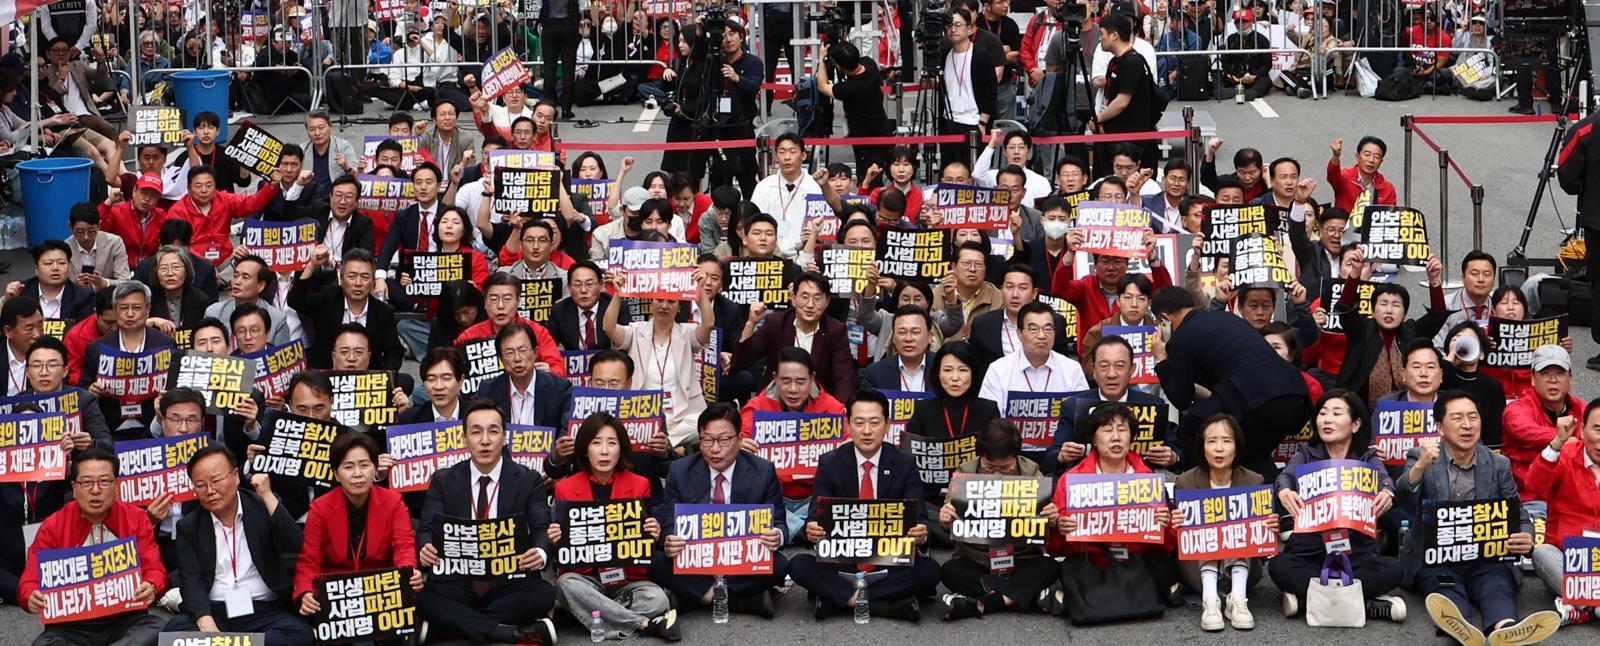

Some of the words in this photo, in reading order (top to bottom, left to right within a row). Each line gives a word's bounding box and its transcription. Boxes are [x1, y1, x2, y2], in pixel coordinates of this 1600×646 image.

[50, 2, 83, 10] SECURITY
[244, 127, 283, 153] 민생파탄
[224, 145, 260, 168] 이재명
[237, 138, 280, 166] 사법파괴
[373, 180, 387, 197] 혐의
[388, 180, 401, 197] 5개
[502, 171, 552, 185] 민생파탄
[502, 185, 550, 199] 사법파괴
[593, 182, 607, 199] 5개
[938, 189, 955, 205] 12개
[956, 189, 974, 204] 혐의
[975, 190, 990, 204] 5개
[991, 189, 1010, 204] 재판
[495, 198, 529, 212] 이재명
[532, 199, 559, 212] OUT
[940, 207, 966, 223] 이재명
[966, 206, 988, 223] 재판
[988, 205, 1008, 222] 재개
[1211, 205, 1265, 225] 민생파탄
[1077, 207, 1114, 224] 제멋대로
[1114, 209, 1152, 228] 농지조사
[246, 227, 262, 246] 12개
[263, 227, 280, 246] 혐의
[282, 225, 296, 245] 5개
[298, 223, 316, 242] 재판
[886, 230, 944, 247] 민생파탄
[1210, 221, 1266, 239] 사법파괴
[1369, 226, 1426, 243] 종북외교
[275, 244, 295, 266] 재판
[623, 246, 660, 269] 제멋대로
[661, 245, 698, 268] 농지조사
[823, 249, 876, 264] 민생파탄
[884, 246, 943, 262] 사법파괴
[1202, 239, 1230, 254] 이재
[1361, 242, 1403, 259] 이재명
[1406, 243, 1429, 259] OU
[412, 253, 464, 269] 민생파탄
[729, 260, 785, 276] 민생파탄
[876, 260, 918, 276] 이재명
[920, 261, 951, 278] OUT
[413, 268, 463, 283] 사법파괴
[728, 275, 783, 290] 사법파괴
[1229, 266, 1269, 289] 이재명
[1271, 267, 1290, 283] OU
[405, 282, 442, 296] 이재명
[721, 289, 760, 305] 이재명
[762, 289, 792, 304] OUT
[1499, 318, 1560, 338] 민생파탄
[266, 341, 304, 374] 농지조사
[465, 340, 497, 361] 민생
[1488, 351, 1533, 367] 이재명
[98, 355, 115, 376] 12개
[116, 356, 135, 377] 혐의
[137, 355, 153, 375] 5개
[154, 350, 172, 371] 재판
[179, 355, 245, 376] 안보참사
[569, 355, 584, 375] 5개
[128, 376, 151, 396] 재판
[176, 372, 242, 392] 종북외교
[329, 373, 388, 393] 민생파탄
[57, 391, 79, 413] 재판
[573, 395, 618, 419] 제멋대로
[618, 393, 661, 419] 농지조사
[894, 398, 915, 420] 혐의
[1007, 398, 1049, 418] 제멋대로
[363, 407, 397, 425] OUT
[1379, 409, 1400, 435] 12개
[1402, 409, 1424, 434] 혐의
[19, 419, 38, 444] 5개
[41, 415, 64, 442] 재판
[273, 418, 338, 444] 안보참사
[754, 419, 797, 444] 제멋대로
[799, 417, 842, 441] 농지조사
[268, 435, 331, 462] 종북외교
[389, 430, 434, 462] 제멋대로
[511, 430, 552, 453] 농지조사
[911, 436, 977, 457] 민생파탄
[10, 447, 36, 473] 재판
[38, 444, 62, 470] 재개
[117, 445, 163, 477] 제멋대로
[252, 454, 303, 477] 이재명
[391, 457, 436, 490] 이나라가
[1297, 466, 1338, 501] 제멋대로
[1340, 464, 1379, 495] 농지조사
[119, 473, 166, 503] 이나라가
[965, 480, 1040, 498] 민생파탄
[1069, 481, 1115, 509] 제멋대로
[1117, 477, 1163, 505] 농지조사
[568, 501, 642, 526] 안보참사
[831, 502, 905, 520] 민생파탄
[964, 498, 1037, 519] 사법파괴
[1203, 495, 1227, 524] 혐의
[1228, 493, 1248, 520] 5개
[1250, 488, 1273, 515] 재판
[1297, 496, 1338, 529] 이나라가
[1436, 501, 1509, 528] 안보참사
[443, 518, 515, 541] 안보참사
[569, 520, 642, 546] 종북외교
[676, 513, 699, 540] 12개
[701, 511, 725, 538] 혐의
[727, 509, 746, 537] 5개
[748, 508, 772, 535] 재판
[830, 519, 904, 538] 사법파괴
[952, 519, 1007, 539] 이재명
[1010, 518, 1049, 538] OUT
[1069, 507, 1115, 537] 이나라가
[1180, 525, 1219, 555] 이재명
[1221, 521, 1247, 550] 재판
[1436, 520, 1509, 547] 종북외교
[443, 537, 516, 559] 종북외교
[558, 542, 613, 565] 이재명
[617, 539, 655, 560] OUT
[677, 542, 715, 569] 이재명
[717, 540, 743, 566] 재판
[746, 539, 771, 563] 재개
[818, 539, 874, 558] 이재명
[877, 537, 915, 557] OUT
[1424, 543, 1479, 566] 이재명
[1483, 541, 1510, 559] OU
[40, 554, 89, 588] 제멋대로
[91, 540, 138, 579] 농지조사
[432, 557, 486, 576] 이재명
[1565, 546, 1589, 573] 12개
[325, 570, 401, 601] 민생파탄
[43, 584, 92, 619] 이나라가
[328, 589, 403, 620] 사법파괴
[318, 614, 374, 641] 이재명
[377, 606, 416, 631] OUT
